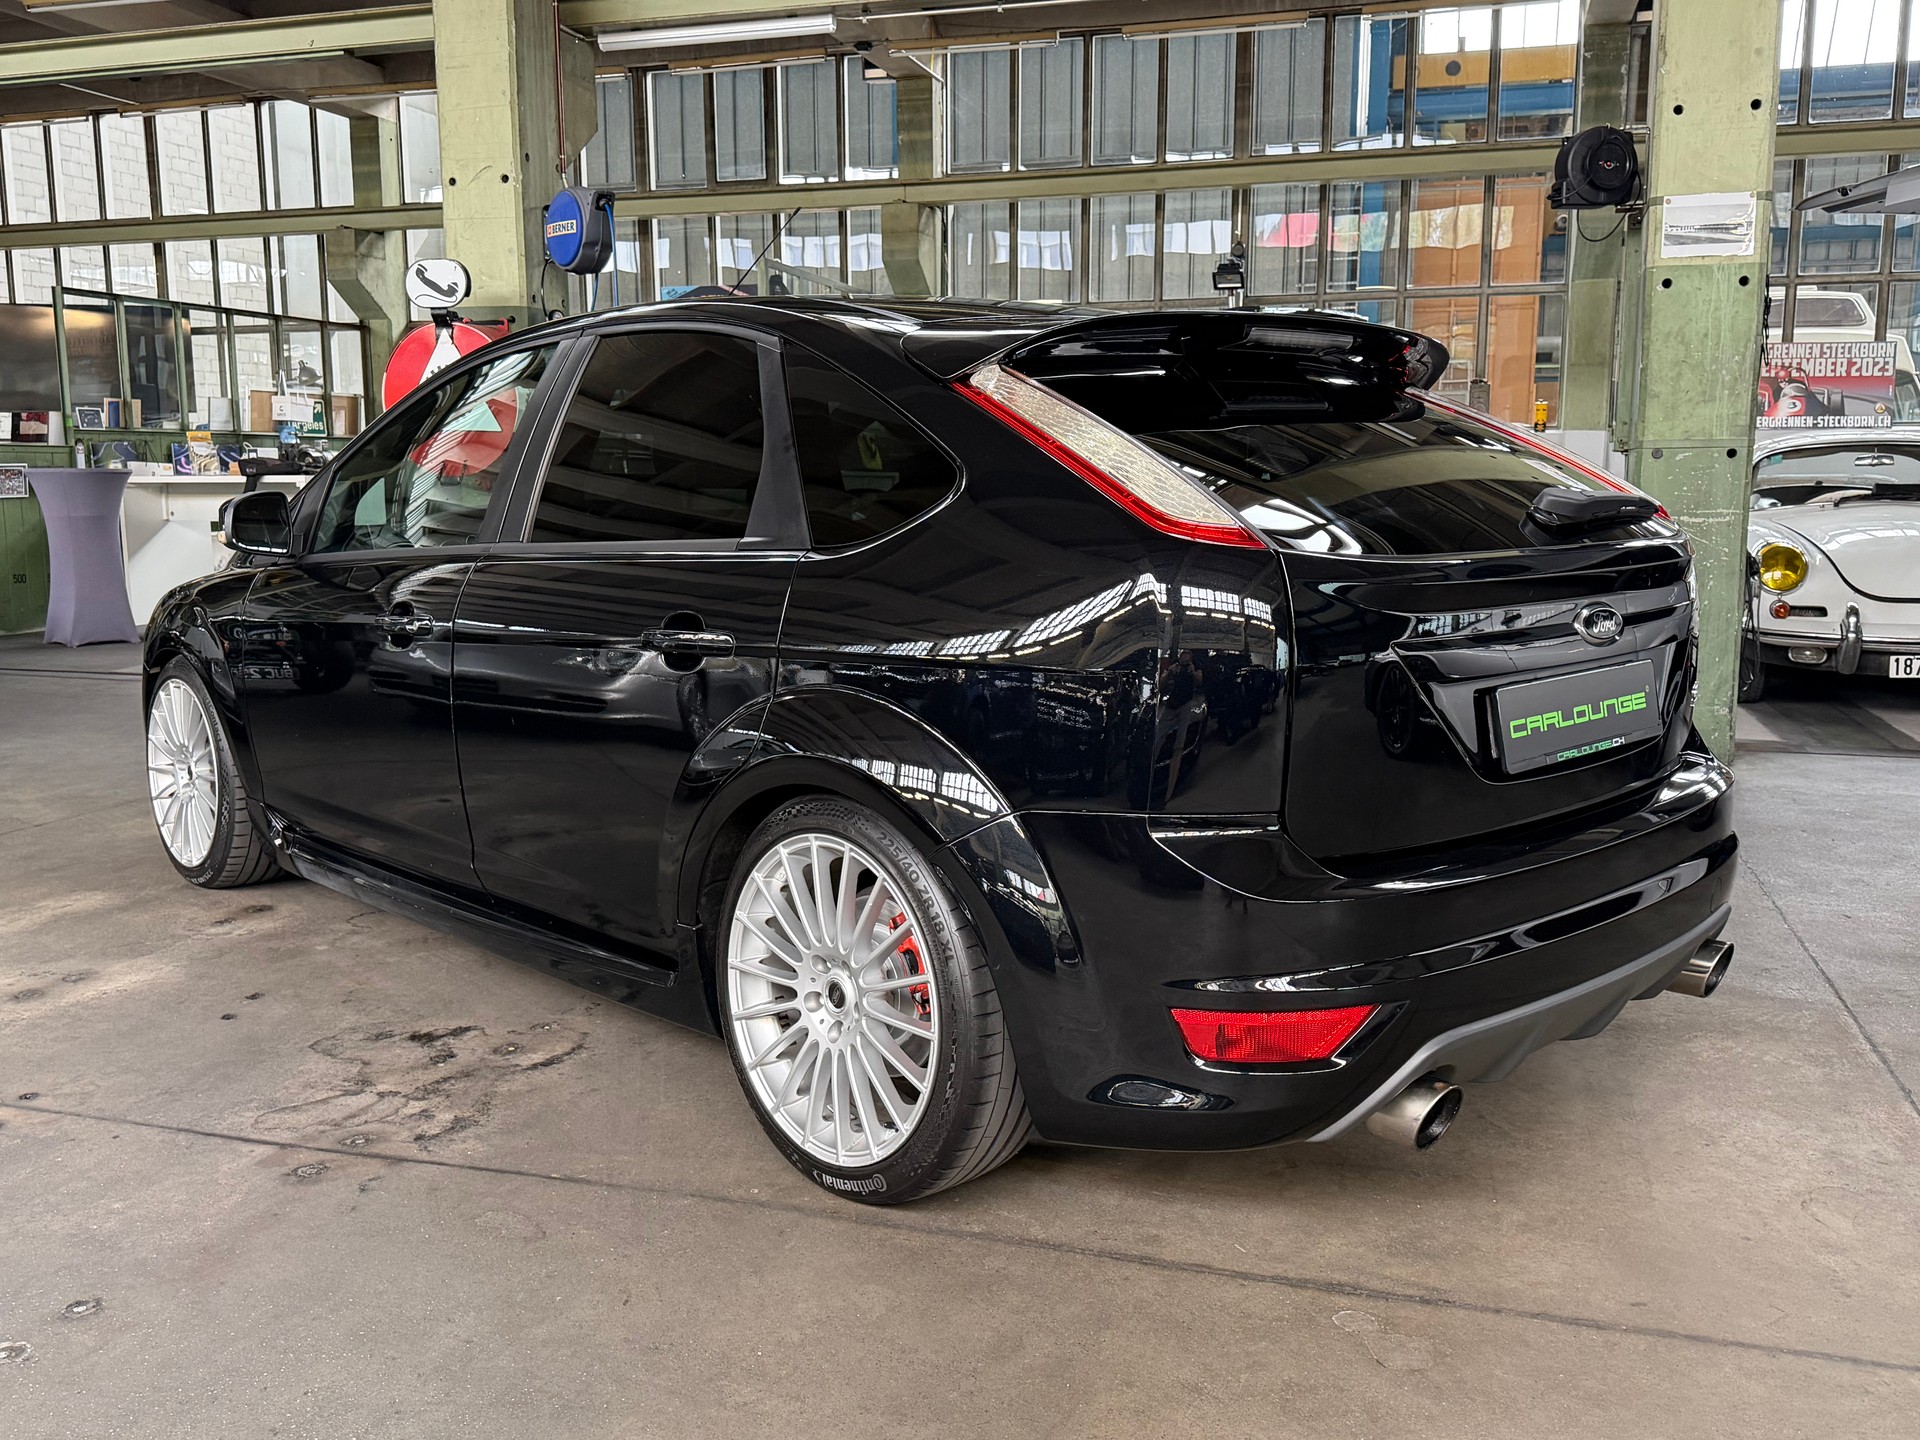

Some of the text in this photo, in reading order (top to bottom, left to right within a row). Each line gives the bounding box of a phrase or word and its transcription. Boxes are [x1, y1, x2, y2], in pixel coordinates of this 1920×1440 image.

[552, 221, 575, 235] BERNER
[1823, 342, 1895, 358] STECKBORN
[1850, 357, 1894, 377] 2023
[13, 573, 27, 584] 500
[1592, 611, 1617, 634] Ford
[1509, 691, 1647, 739] CARLOUNGE
[1557, 736, 1625, 761] CARLOUNGE.CH
[876, 832, 921, 883] 225/40
[917, 885, 935, 912] ZR
[931, 911, 946, 935] 18
[940, 938, 954, 968] XL
[822, 1173, 888, 1195] Continental
